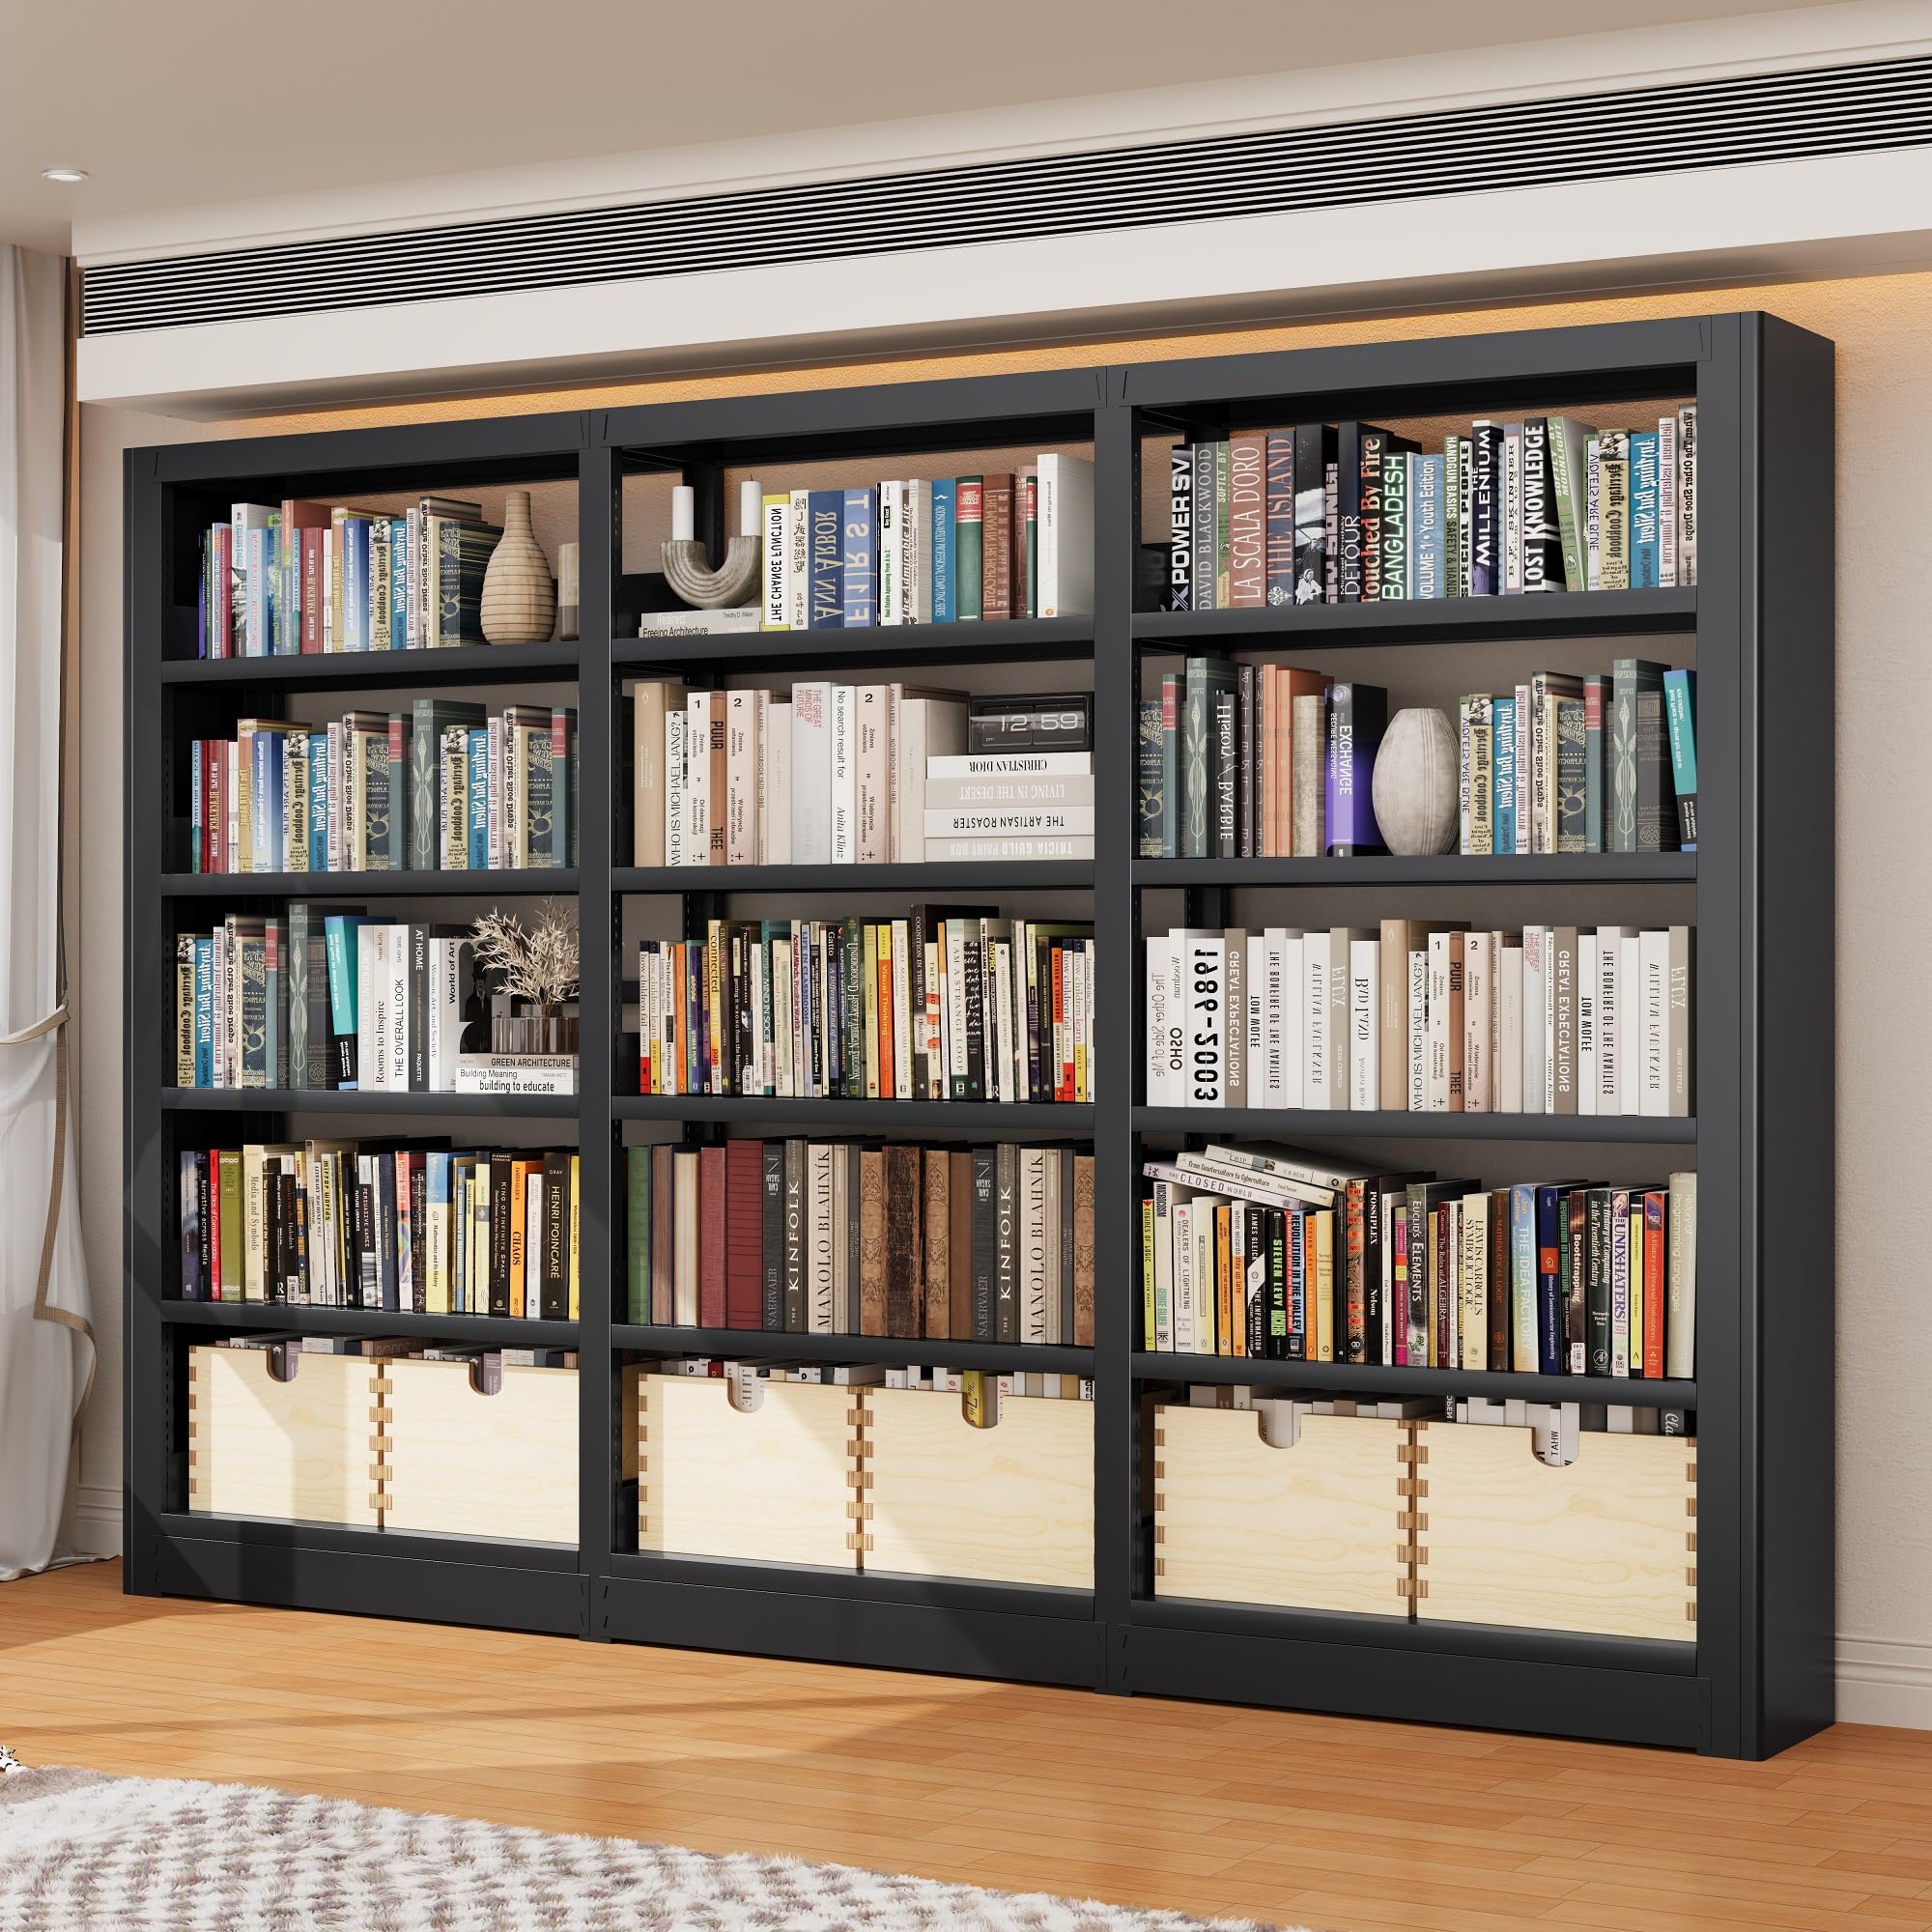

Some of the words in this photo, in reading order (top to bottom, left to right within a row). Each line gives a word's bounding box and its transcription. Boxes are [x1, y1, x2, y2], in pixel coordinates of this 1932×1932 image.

[1548, 425, 1554, 440] BY
[1360, 439, 1379, 477] Fire
[1447, 438, 1456, 482] HANDGUN
[1555, 423, 1569, 496] MOONLIGHT
[1233, 447, 1261, 502] D'ORO
[1268, 439, 1293, 519] ISLAND
[1524, 425, 1546, 540] KNOWLEDGE
[1551, 452, 1561, 497] SOFTLY
[1199, 449, 1211, 554] BLACKWOOD
[1361, 486, 1382, 510] By
[1447, 486, 1456, 518] BASICS
[1477, 430, 1490, 566] MILLENIUM
[1172, 497, 1190, 583] POWER
[1234, 509, 1261, 568] SCALA
[1382, 456, 1404, 600] BANGLADESH
[1268, 531, 1293, 579] THE
[1345, 516, 1360, 594] DETOUR
[1361, 518, 1379, 602] Touched
[1524, 546, 1544, 591] LOST
[1199, 561, 1211, 610] DAVID
[1234, 577, 1261, 599] LA
[669, 626, 708, 636] Architecture
[838, 691, 845, 703] No
[805, 714, 811, 724] OF
[1001, 716, 1027, 731] 12
[1041, 713, 1077, 729] 59
[671, 723, 680, 763] JANG?
[711, 722, 724, 750] PUUR
[969, 761, 992, 773] DIOR
[996, 759, 1047, 772] CHRISTIAN
[671, 767, 680, 816] MICHAEL
[671, 819, 680, 831] IS
[953, 818, 996, 829] ROASTER
[1000, 817, 1041, 828] ARTISAN
[1046, 816, 1065, 827] THE
[711, 827, 724, 849] THEE
[838, 835, 846, 858] Klinz
[415, 929, 423, 941] AT
[449, 960, 455, 970] of
[953, 948, 960, 963] AM
[395, 980, 404, 1007] LOOK
[376, 1001, 386, 1034] Inspire
[395, 1009, 404, 1055] OVERALL
[376, 1037, 384, 1046] to
[376, 1050, 384, 1083] Rooms
[395, 1059, 404, 1077] THE
[518, 1059, 570, 1067] ARCHITECTURE
[479, 1080, 510, 1094] building
[513, 1081, 520, 1091] to
[524, 1082, 554, 1092] educate
[815, 1151, 831, 1232] BLAHNÍK
[1156, 1184, 1166, 1217] MICROCOSM
[1180, 1174, 1225, 1192] CLOSED
[1228, 1186, 1252, 1197] WORLD
[551, 1186, 559, 1218] HENRI
[250, 1219, 259, 1251] Symbols
[551, 1223, 560, 1279] POINCARÉ
[788, 1181, 798, 1292] KINFOLK
[1273, 1239, 1283, 1277] STEVEN
[1412, 1242, 1424, 1301] ELEMENTS
[1614, 1224, 1626, 1320] UNIX-HATERS
[817, 1240, 831, 1326] MANOLO
[1273, 1283, 1283, 1306] LEVY
[1271, 1310, 1286, 1335] HACKERS
